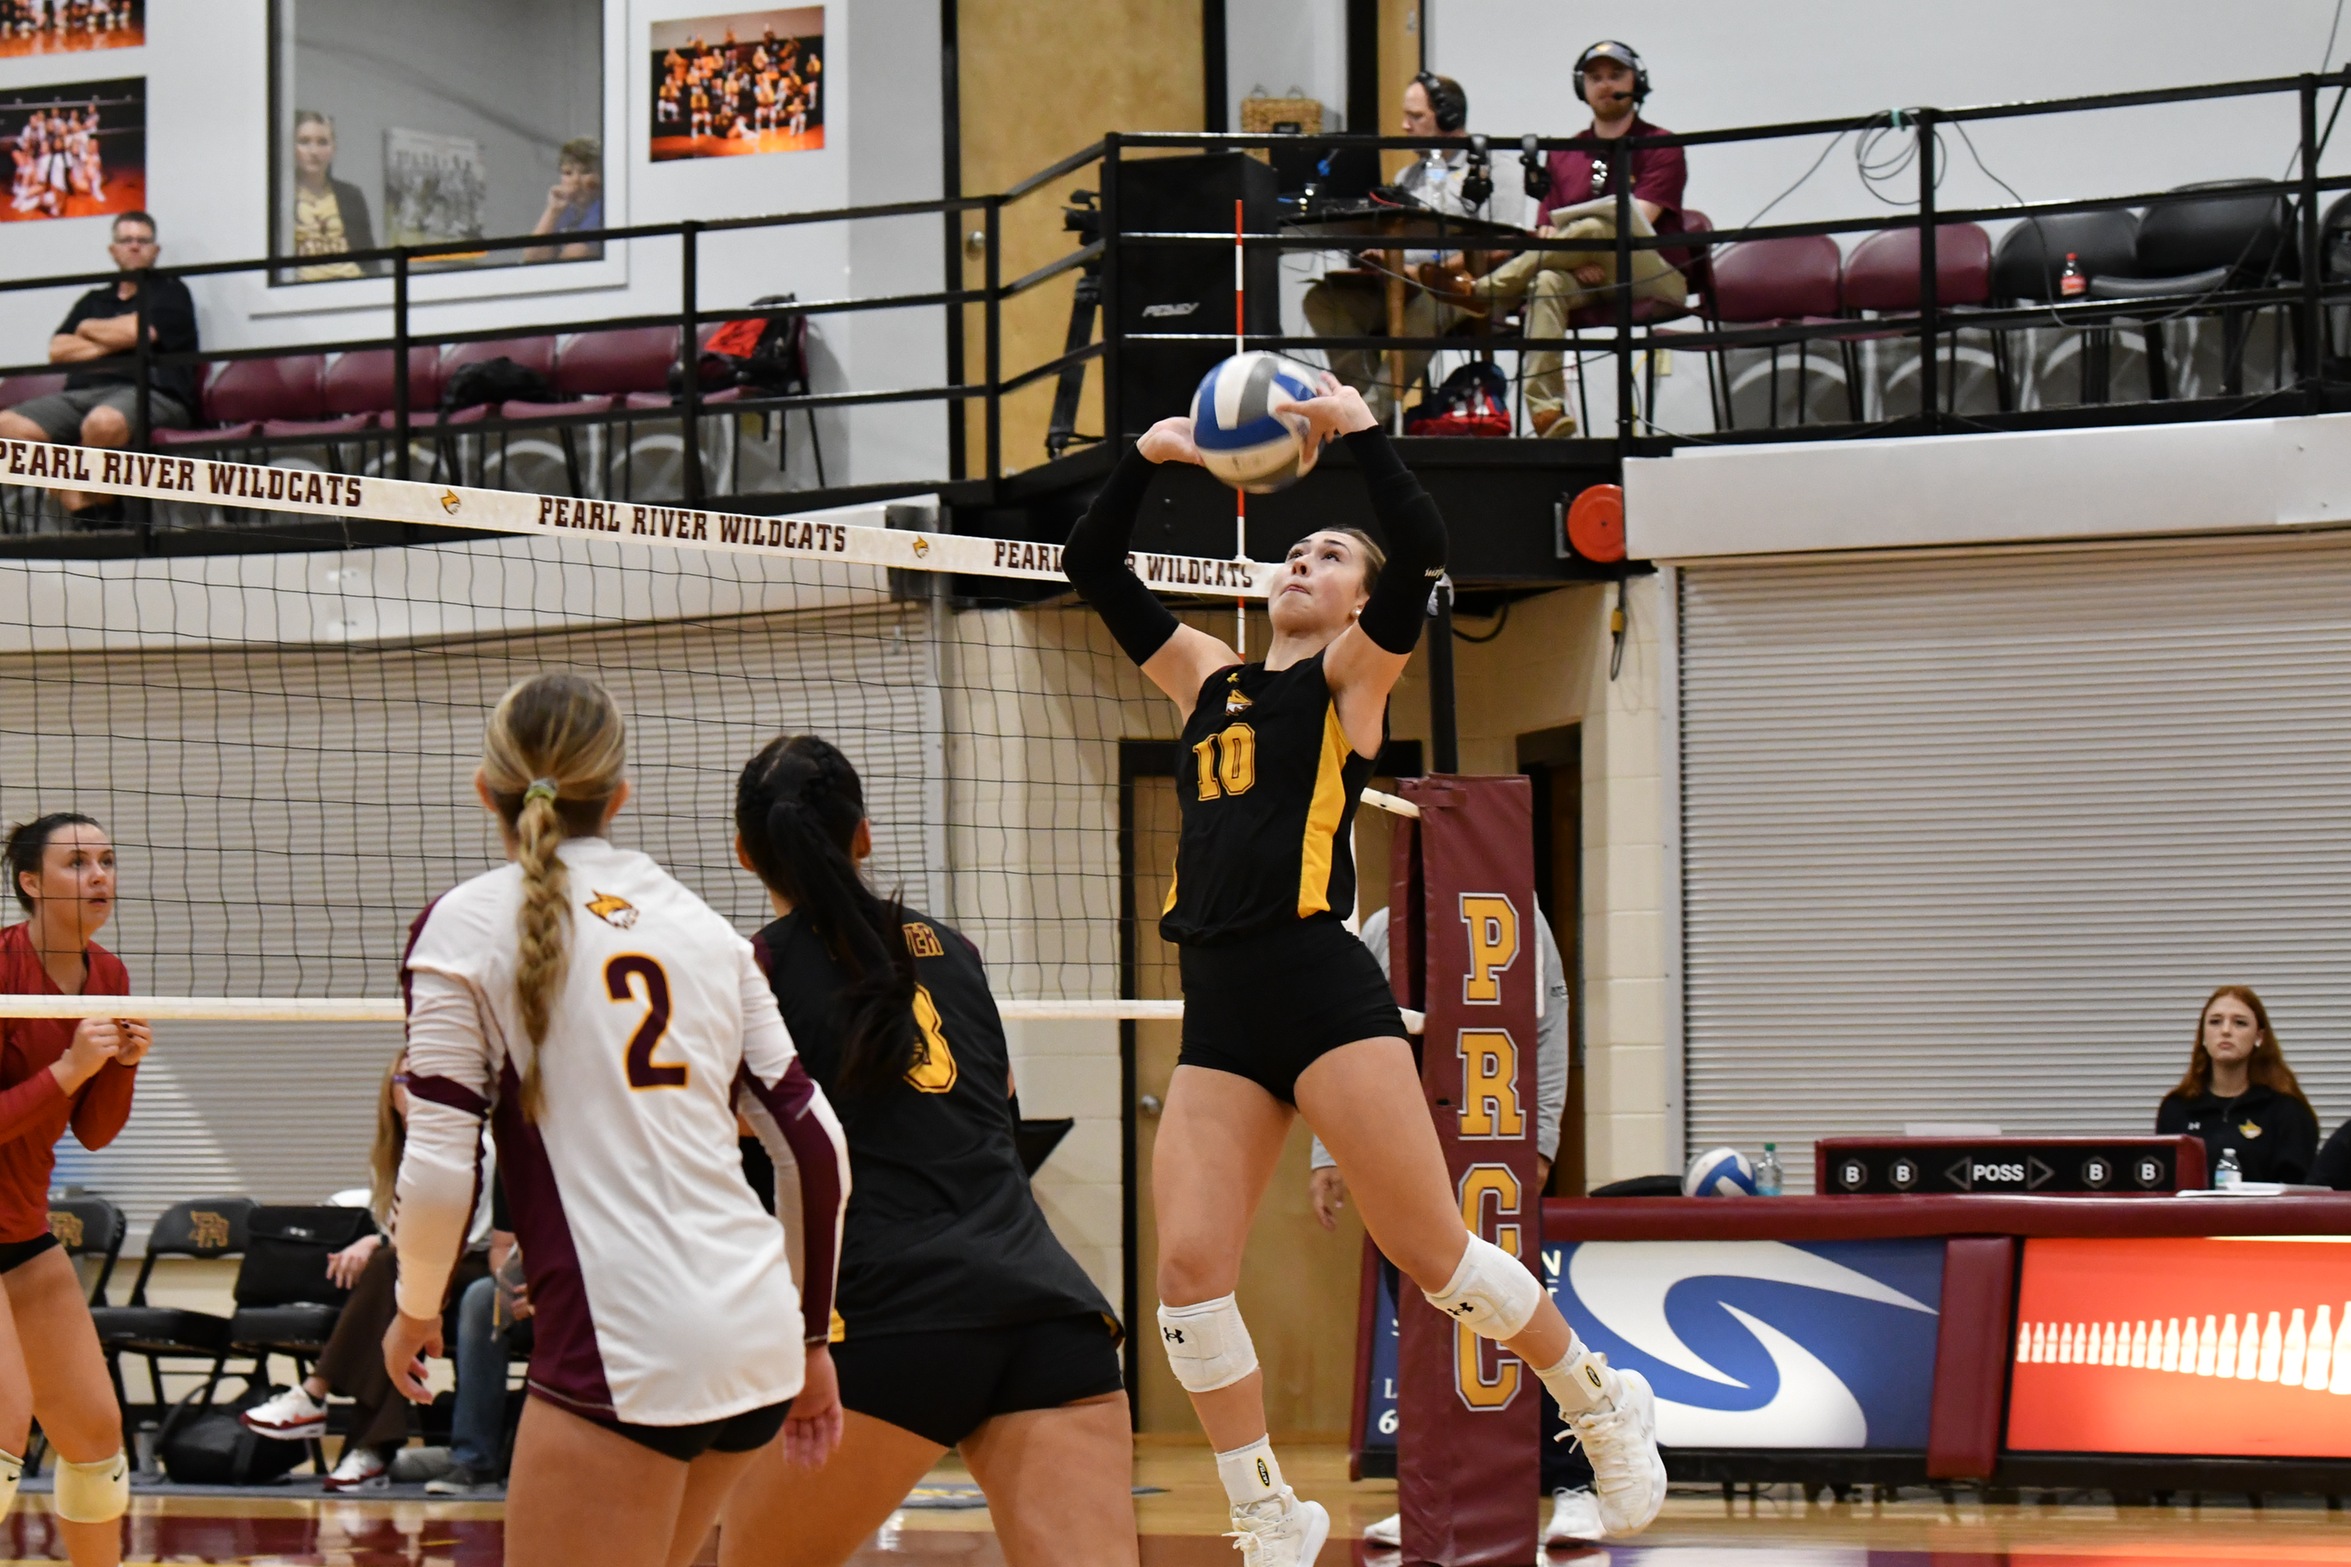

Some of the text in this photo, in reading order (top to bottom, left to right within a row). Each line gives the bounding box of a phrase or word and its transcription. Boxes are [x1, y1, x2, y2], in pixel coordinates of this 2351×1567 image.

[102, 451, 195, 491] RIVER
[208, 462, 362, 508] WILDCATS
[538, 496, 846, 552] PEARL RIVER WILDCATS
[993, 540, 1063, 573] PEARL
[1146, 554, 1252, 588] WILDCATS
[1192, 722, 1256, 802] 10
[602, 951, 691, 1094] 2
[1846, 1163, 2156, 1183] B B POSS B B
